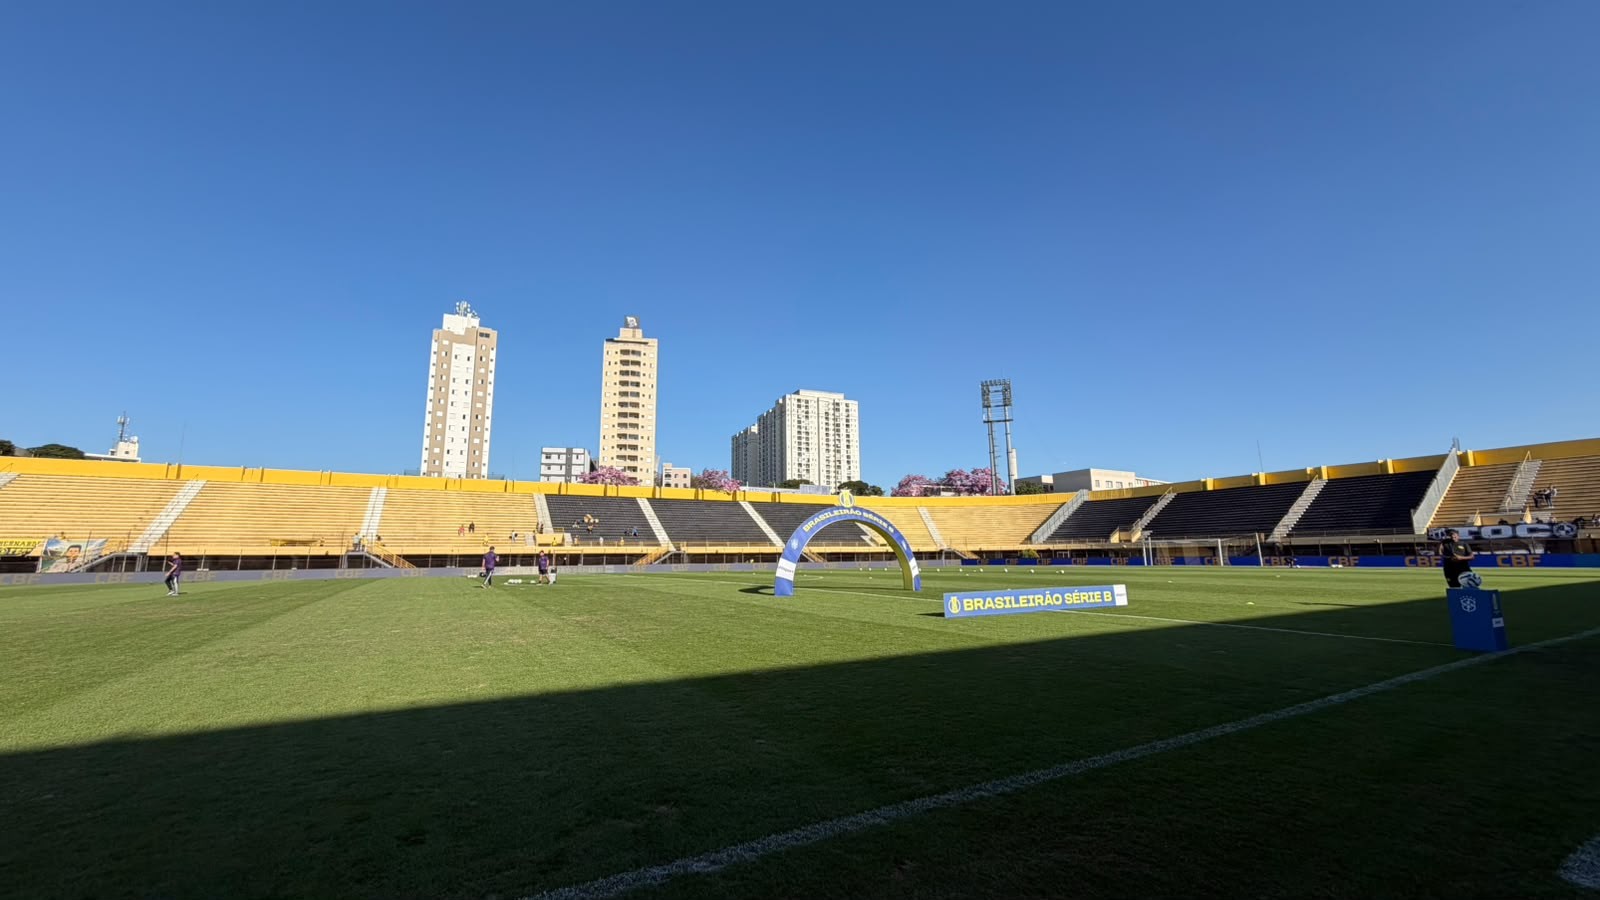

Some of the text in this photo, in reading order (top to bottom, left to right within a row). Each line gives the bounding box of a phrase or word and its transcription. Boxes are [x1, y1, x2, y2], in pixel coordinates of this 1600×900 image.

[803, 508, 895, 534] BRASILEIRÃO SÉRIE B
[1072, 558, 1088, 566] CBF
[1111, 557, 1129, 566] CBF
[1328, 556, 1360, 566] CBF
[1405, 556, 1442, 567] CBF
[1496, 554, 1542, 567] CBF
[95, 571, 131, 583] CBF
[964, 590, 1113, 611] BRASILEIRÃO SÉRIE B
